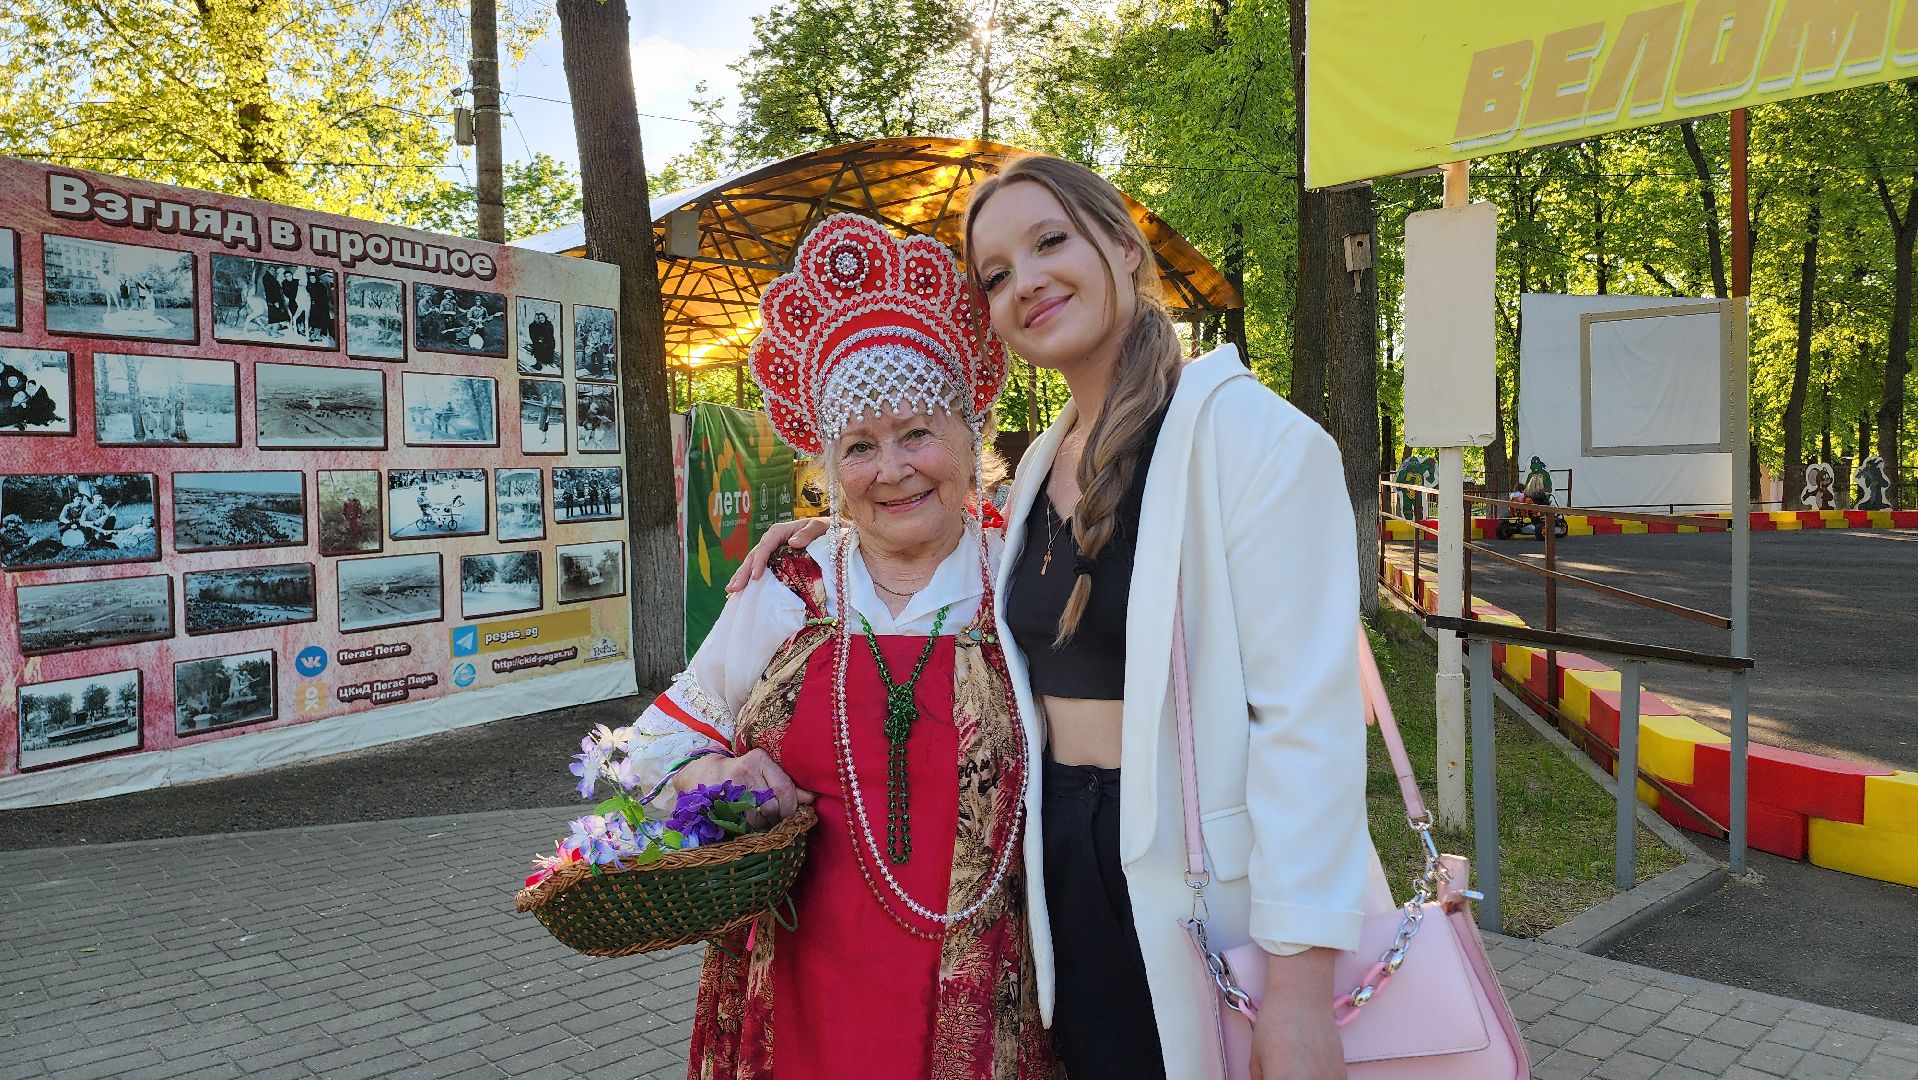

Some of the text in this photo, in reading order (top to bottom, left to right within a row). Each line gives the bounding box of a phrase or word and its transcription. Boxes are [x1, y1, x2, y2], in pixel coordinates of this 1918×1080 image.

[1452, 0, 1918, 152] ВЕЛОМ
[48, 173, 495, 279] Взгляд в прошлое
[339, 643, 408, 661] Пегас Пегас
[339, 673, 434, 699] ЦКиД Пегас Парк
[372, 688, 405, 702] Пегас
